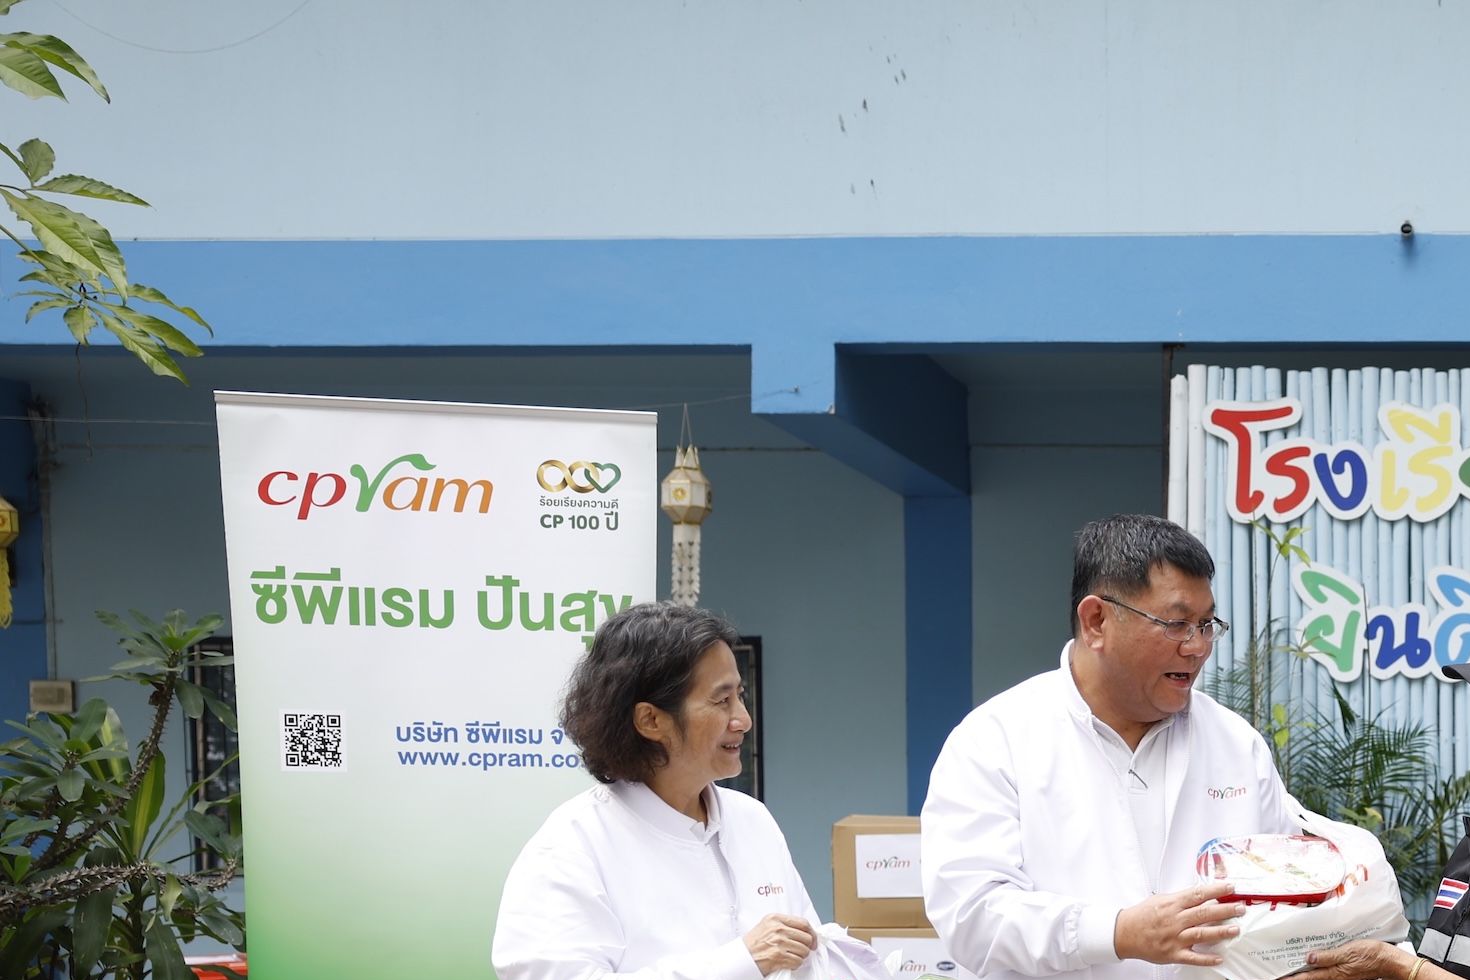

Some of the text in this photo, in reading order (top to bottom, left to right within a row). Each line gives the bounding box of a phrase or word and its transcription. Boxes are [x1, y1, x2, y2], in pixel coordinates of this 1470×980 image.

[257, 453, 494, 520] cpram
[538, 495, 619, 510] ร้อยเรียงความดี
[539, 511, 619, 531] CP 100 ปี
[250, 565, 455, 629] ซีพีแรม
[396, 720, 459, 744] บริษัท
[465, 720, 544, 745] ซีพีแรม
